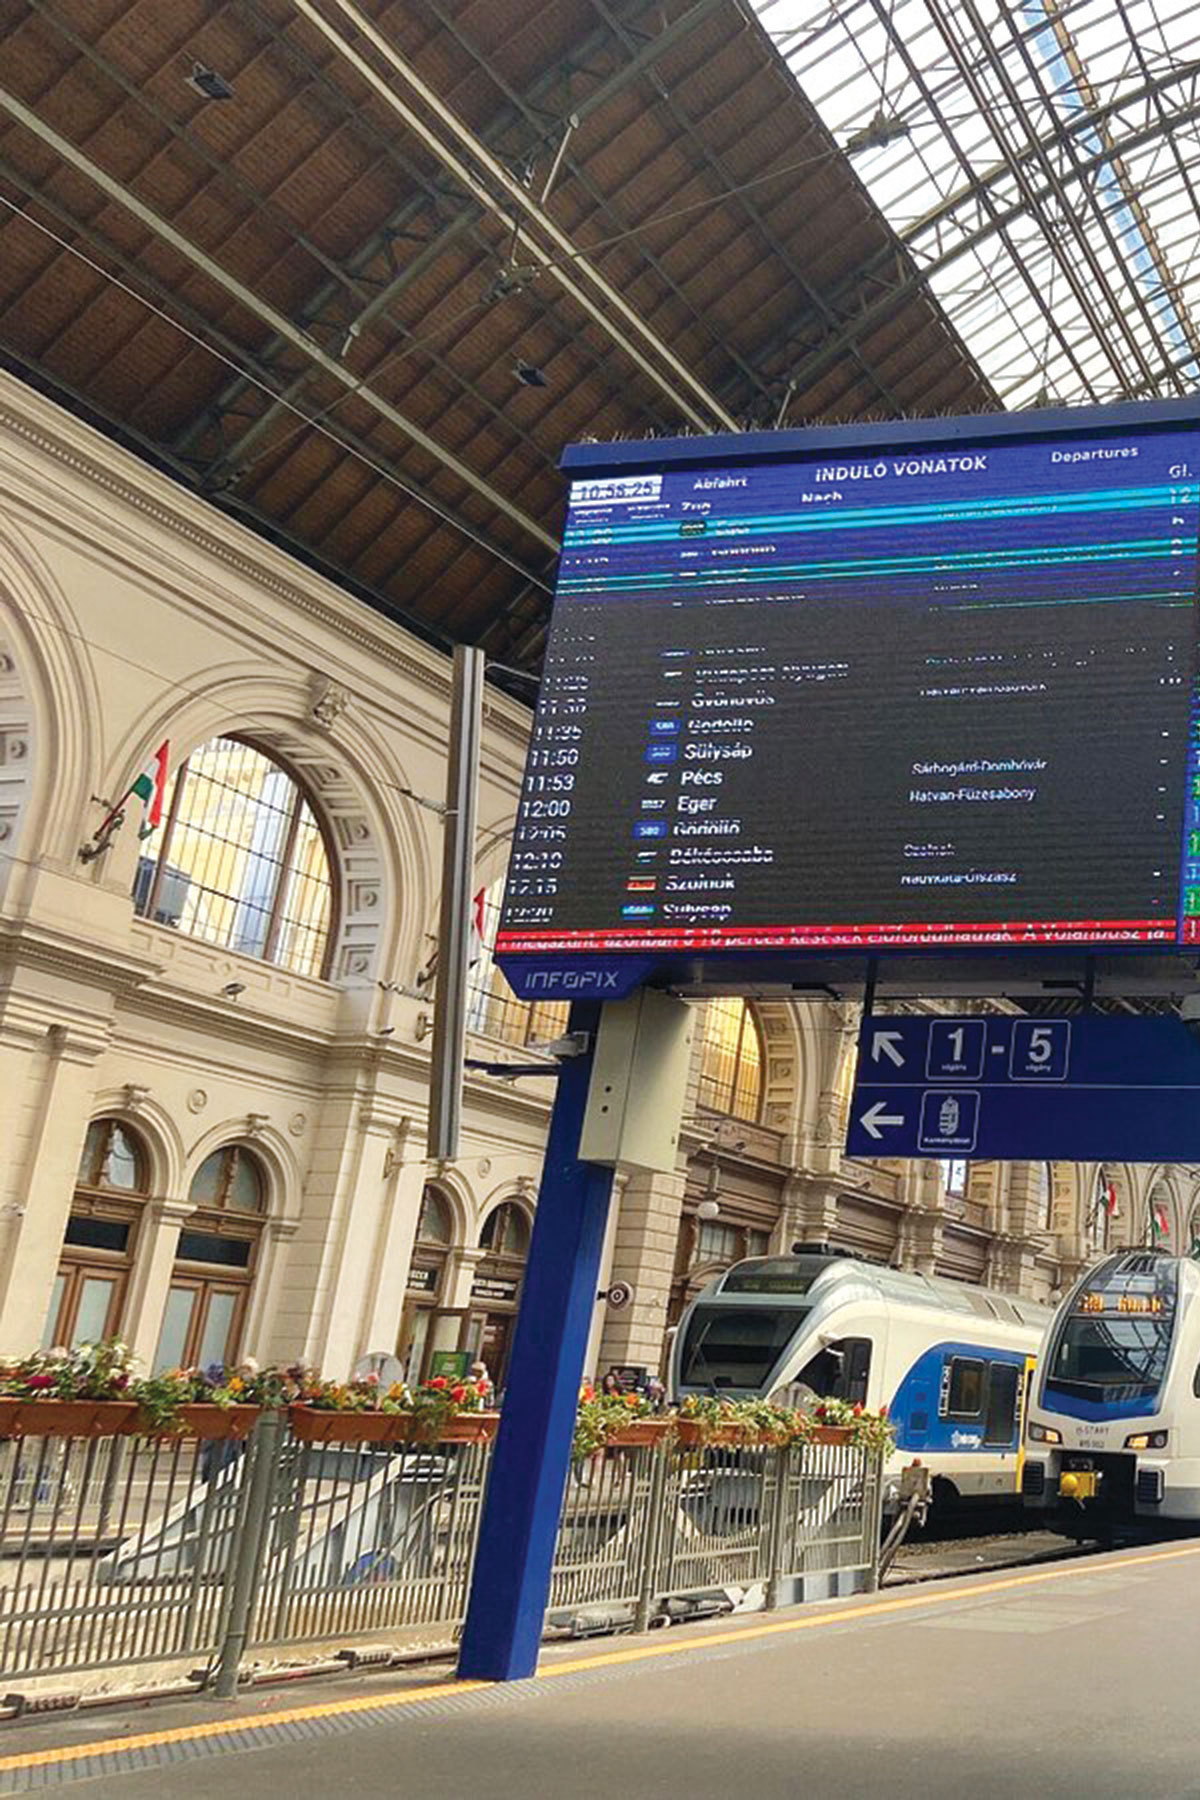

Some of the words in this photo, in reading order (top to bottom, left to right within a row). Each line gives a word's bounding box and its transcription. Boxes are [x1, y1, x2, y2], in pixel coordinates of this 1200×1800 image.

[894, 455, 987, 477] VONATOK
[1051, 447, 1139, 463] Departures
[694, 477, 749, 490] Abfahrt
[526, 774, 575, 792] 11:53
[680, 768, 723, 785] Pécs
[522, 800, 571, 818] 12:00
[677, 795, 718, 814] Eger
[525, 970, 620, 988] INFOFIX
[947, 1028, 964, 1061] 1
[1028, 1028, 1053, 1063] 5
